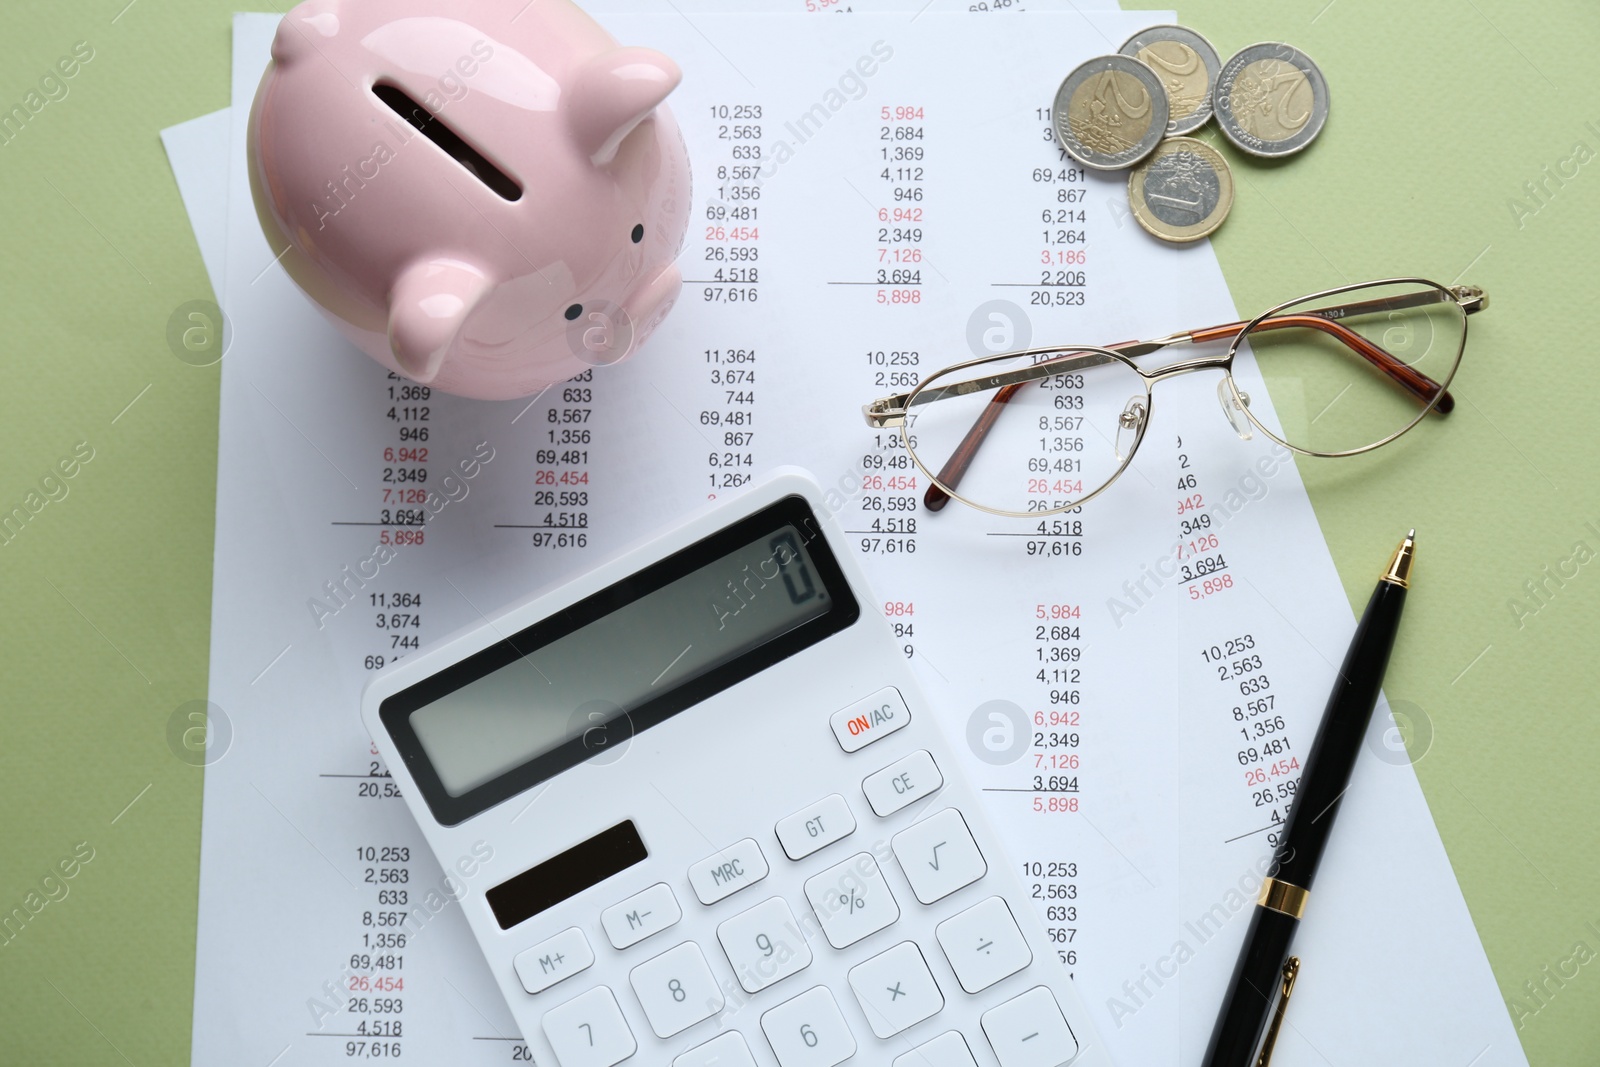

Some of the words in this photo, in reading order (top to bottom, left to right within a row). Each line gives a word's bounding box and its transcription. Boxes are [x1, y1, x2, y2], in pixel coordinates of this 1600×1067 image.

[710, 106, 762, 121] 10,253
[881, 107, 924, 122] 5,984
[719, 126, 762, 140] 2,563
[880, 127, 924, 142] 2,684
[733, 146, 761, 159] 633
[882, 148, 924, 162] 1,369
[717, 167, 760, 181] 8,567
[880, 168, 923, 182] 4,112
[1033, 169, 1085, 183] 69,481
[718, 187, 760, 202] 1,356
[894, 188, 923, 201] 946
[1058, 189, 1086, 203] 867
[706, 208, 758, 222] 69,481
[879, 209, 922, 223] 6,942
[1042, 210, 1086, 225] 6,214
[706, 228, 758, 242] 26,454
[878, 229, 922, 243] 2,349
[1043, 231, 1086, 245] 1,264
[705, 248, 758, 262] 26,593
[878, 249, 922, 264] 7,126
[1041, 251, 1086, 265] 3,186
[714, 268, 758, 283] 4,518
[877, 270, 921, 284] 3,694
[1041, 271, 1085, 286] 2,206
[704, 289, 757, 304] 97,616
[877, 290, 920, 305] 5,898
[1031, 292, 1085, 306] 20,523
[704, 350, 755, 364] 11,364
[866, 352, 919, 366] 10,253
[711, 371, 755, 385] 3,674
[875, 373, 919, 387] 2,563
[1040, 375, 1084, 390] 2,563
[388, 387, 430, 401] 1,369
[563, 389, 592, 402] 633
[726, 391, 754, 404] 744
[1054, 396, 1084, 409] 633
[387, 407, 430, 422] 4,112
[548, 410, 591, 424] 8,567
[700, 412, 752, 426] 69,481
[1039, 417, 1084, 431] 8,567
[400, 428, 428, 441] 946
[548, 430, 590, 445] 1,356
[724, 433, 753, 446] 867
[1040, 438, 1083, 452] 1,356
[384, 449, 428, 463] 6,942
[536, 451, 588, 466] 69,481
[709, 454, 752, 468] 6,214
[863, 456, 916, 470] 69,481
[1028, 458, 1082, 473] 69,481
[383, 469, 427, 483] 2,349
[535, 471, 588, 486] 26,454
[863, 477, 916, 491] 26,454
[1028, 479, 1082, 494] 26,454
[383, 490, 426, 504] 7,126
[535, 492, 588, 507] 26,593
[862, 498, 916, 512] 26,593
[381, 510, 424, 525] 3,694
[544, 513, 587, 527] 4,518
[872, 518, 916, 533] 4,518
[1037, 521, 1082, 536] 4,518
[380, 531, 424, 546] 5,898
[533, 534, 587, 549] 97,616
[861, 539, 916, 554] 97,616
[1027, 542, 1082, 557] 97,616
[1181, 554, 1226, 580] 3,694
[1189, 574, 1233, 600] 5,898
[370, 593, 421, 609] 11,364
[1036, 605, 1081, 620] 5,984
[376, 614, 420, 629] 3,674
[1036, 626, 1080, 641] 2,684
[391, 636, 419, 649] 744
[1202, 635, 1255, 663] 10,253
[1037, 647, 1080, 662] 1,369
[1218, 655, 1263, 681] 2,563
[1036, 669, 1080, 684] 4,112
[1240, 675, 1270, 695] 633
[1050, 690, 1080, 704] 946
[1233, 695, 1275, 721] 8,567
[847, 704, 895, 737] ON/AC
[1034, 712, 1079, 727] 6,942
[1241, 716, 1285, 741] 1,356
[1034, 733, 1079, 748] 2,349
[1238, 737, 1291, 765] 69,481
[1034, 755, 1079, 770] 7,126
[1245, 756, 1300, 786] 26,454
[359, 783, 403, 798] 20,52
[892, 770, 915, 796] CE
[1033, 776, 1079, 792] 3,694
[1033, 798, 1079, 813] 5,898
[805, 814, 826, 837] GT
[357, 847, 409, 863] 10,253
[365, 869, 409, 884] 2,563
[710, 859, 745, 886] MRC
[1023, 862, 1077, 878] 10,253
[379, 891, 408, 905] 633
[1032, 884, 1077, 900] 2,563
[363, 912, 407, 927] 8,567
[1047, 906, 1077, 921] 633
[363, 934, 406, 949] 1,356
[755, 933, 773, 957] 9
[350, 955, 403, 970] 69,481
[538, 950, 565, 974] M+
[349, 977, 404, 993] 26,454
[668, 978, 687, 1001] 8
[348, 999, 403, 1014] 26,593
[357, 1021, 402, 1037] 4,518
[579, 1022, 594, 1047] 7
[799, 1024, 818, 1047] 6
[346, 1042, 401, 1058] 97,616
